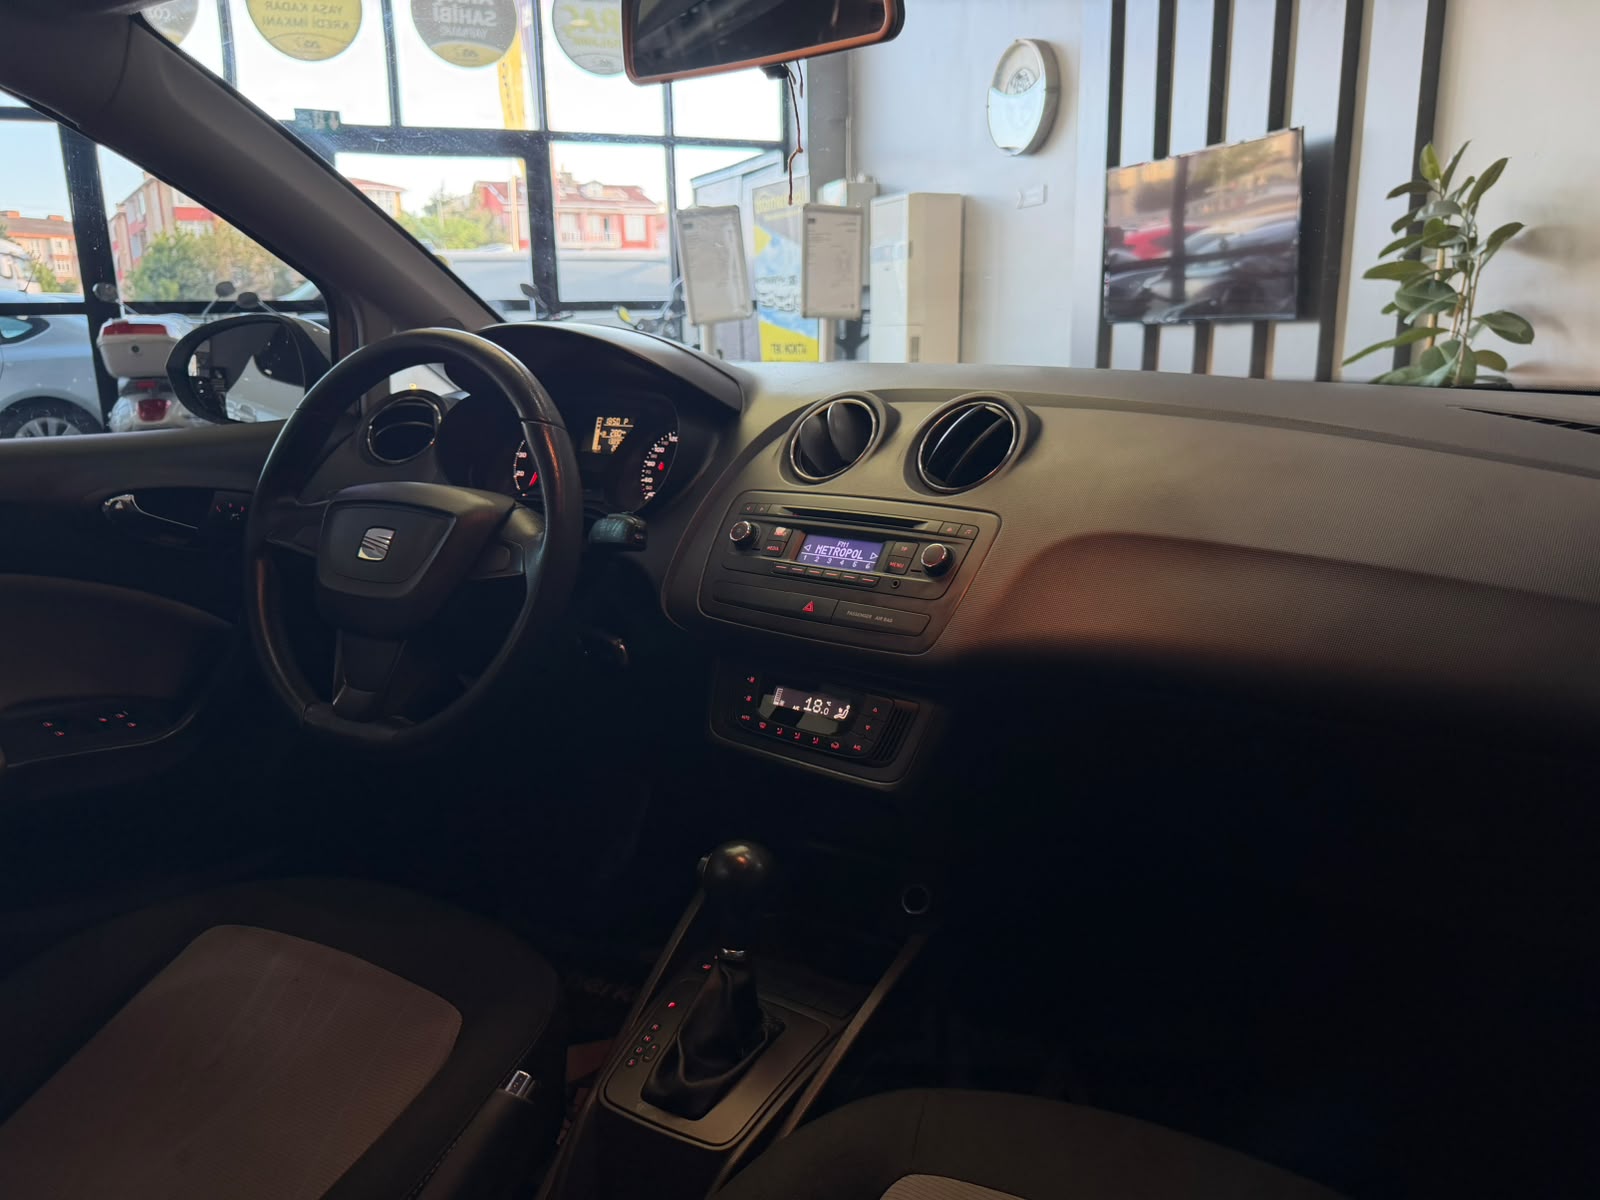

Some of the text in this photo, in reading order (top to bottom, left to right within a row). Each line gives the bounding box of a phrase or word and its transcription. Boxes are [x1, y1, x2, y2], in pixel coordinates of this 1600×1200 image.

[837, 540, 849, 548] FM1
[814, 544, 863, 560] METROPOL
[889, 561, 905, 569] MENU
